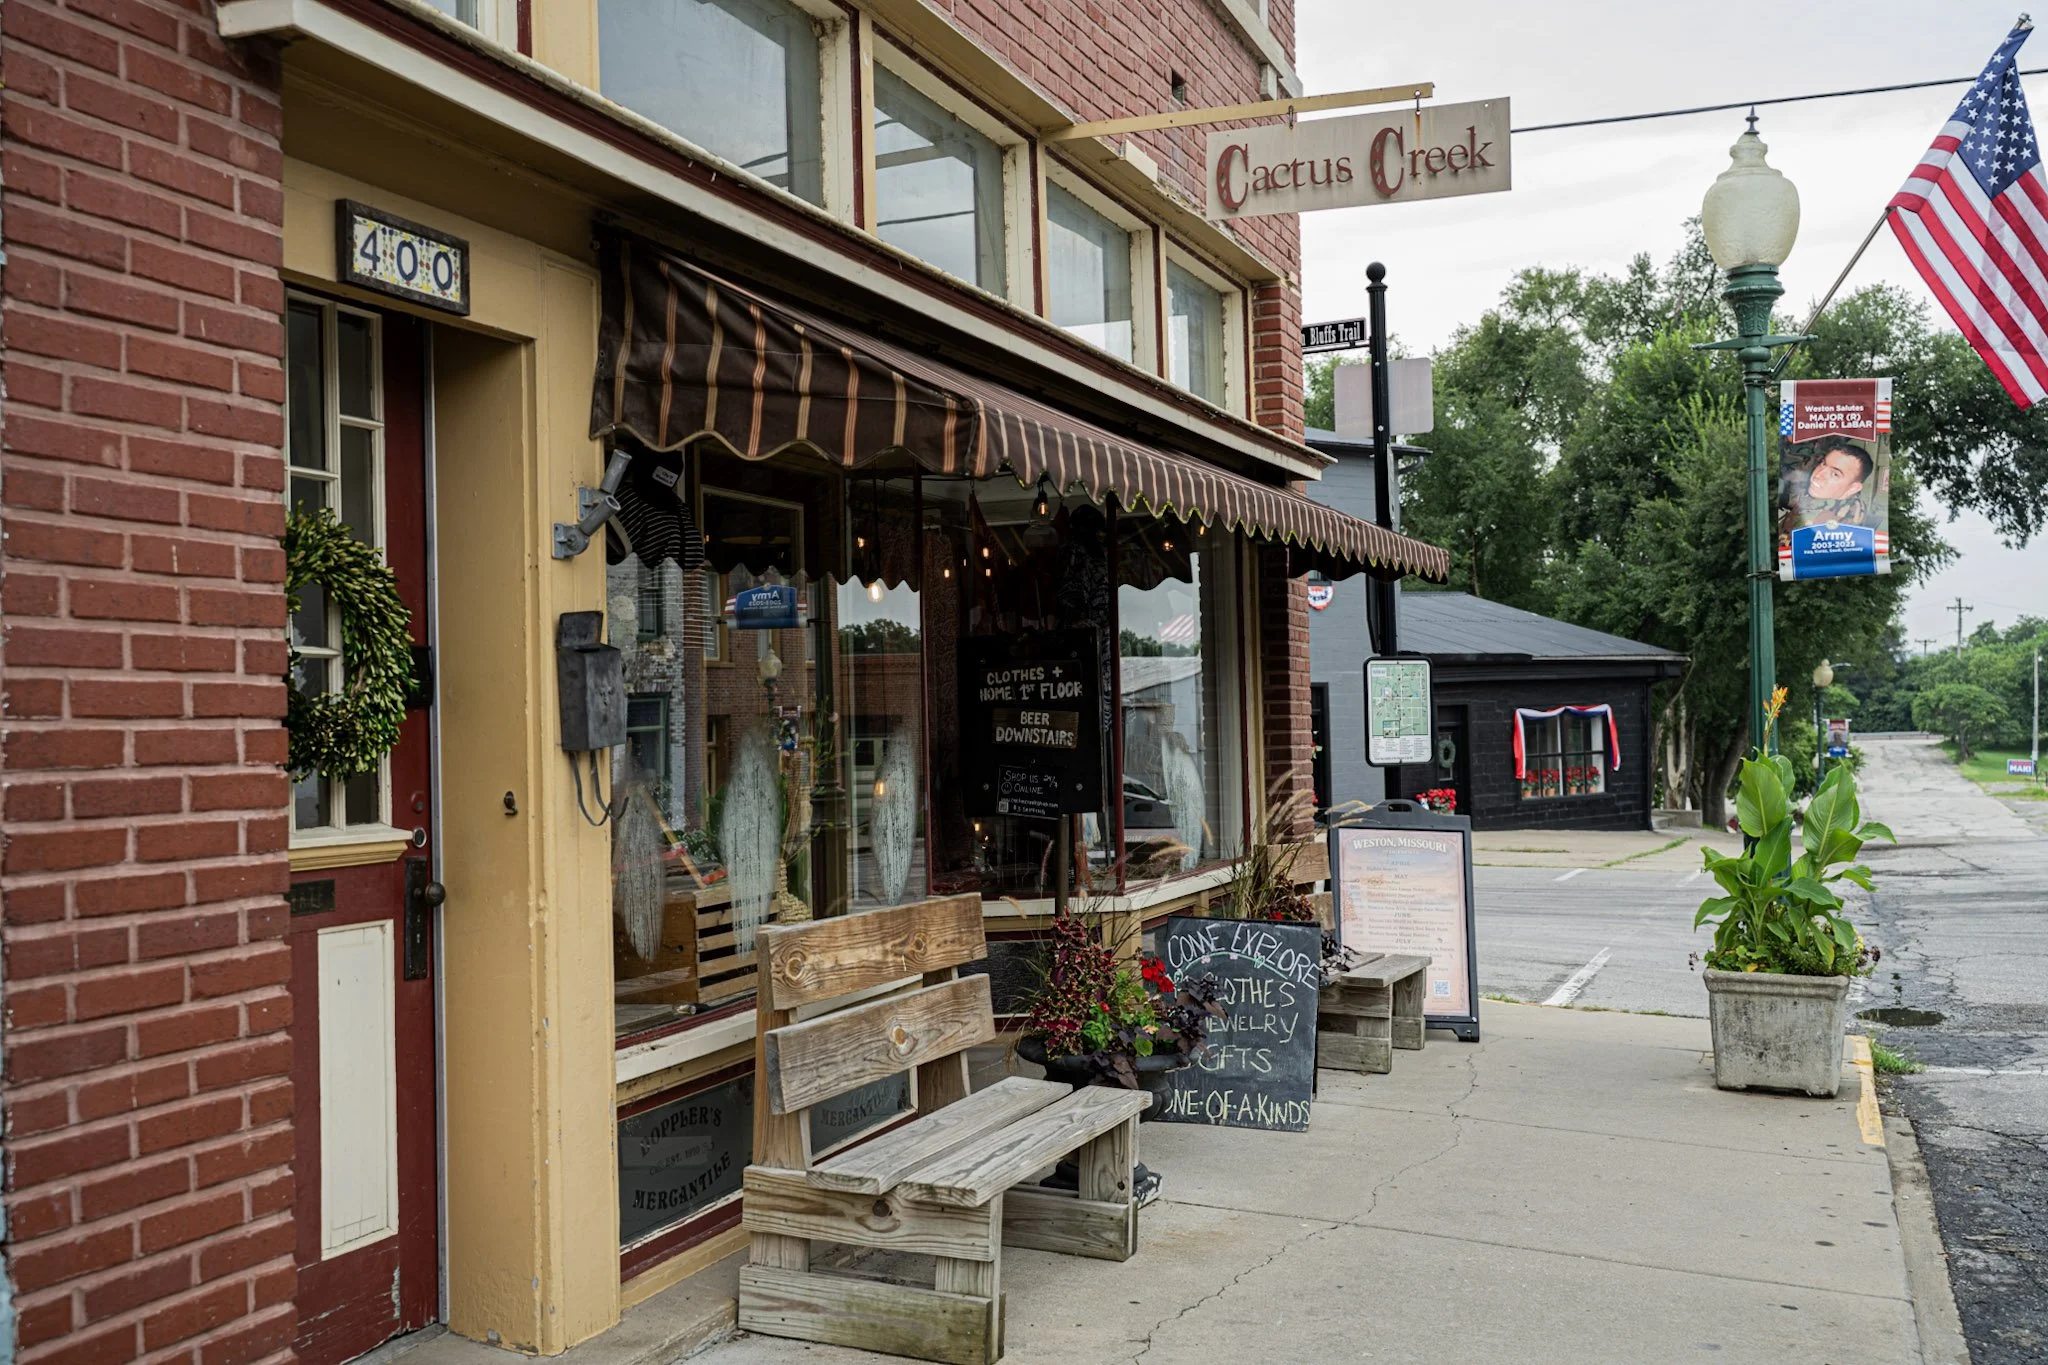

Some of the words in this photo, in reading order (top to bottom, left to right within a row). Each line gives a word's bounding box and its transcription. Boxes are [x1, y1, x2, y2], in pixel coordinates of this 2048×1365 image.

[1216, 143, 1353, 210] Cactus
[1370, 126, 1495, 196] Creek
[360, 227, 453, 291] 400
[1310, 325, 1337, 346] Bluffs
[1338, 322, 1361, 341] Trail
[1836, 404, 1864, 412] Salutes
[1798, 421, 1827, 429] Daniel
[1829, 421, 1839, 429] D.
[1841, 420, 1872, 428] LaBAR
[1809, 414, 1844, 422] MAJOR
[1846, 413, 1861, 422] (R)
[1811, 540, 1856, 549] 2003-2023
[1813, 530, 1853, 542] Army
[986, 667, 1045, 685] CLOTHES
[979, 686, 1011, 702] HOME
[1040, 681, 1083, 700] FLOOR
[1020, 711, 1050, 725] BEER
[995, 727, 1074, 746] DOWNSTAIRS
[1003, 769, 1026, 782] SHOP
[1014, 783, 1043, 795] ONLINE
[1353, 838, 1396, 850] WESTON,
[1398, 837, 1447, 853] MISSOURI
[1168, 923, 1225, 969] COME
[1230, 923, 1320, 991] EXPLORE
[1205, 1012, 1299, 1044] EWELRY
[1164, 1088, 1200, 1116] NE
[1206, 1089, 1234, 1120] OF
[1237, 1093, 1254, 1121] A
[1257, 1092, 1310, 1127] KINDS
[632, 1151, 732, 1211] MERCANTILE
